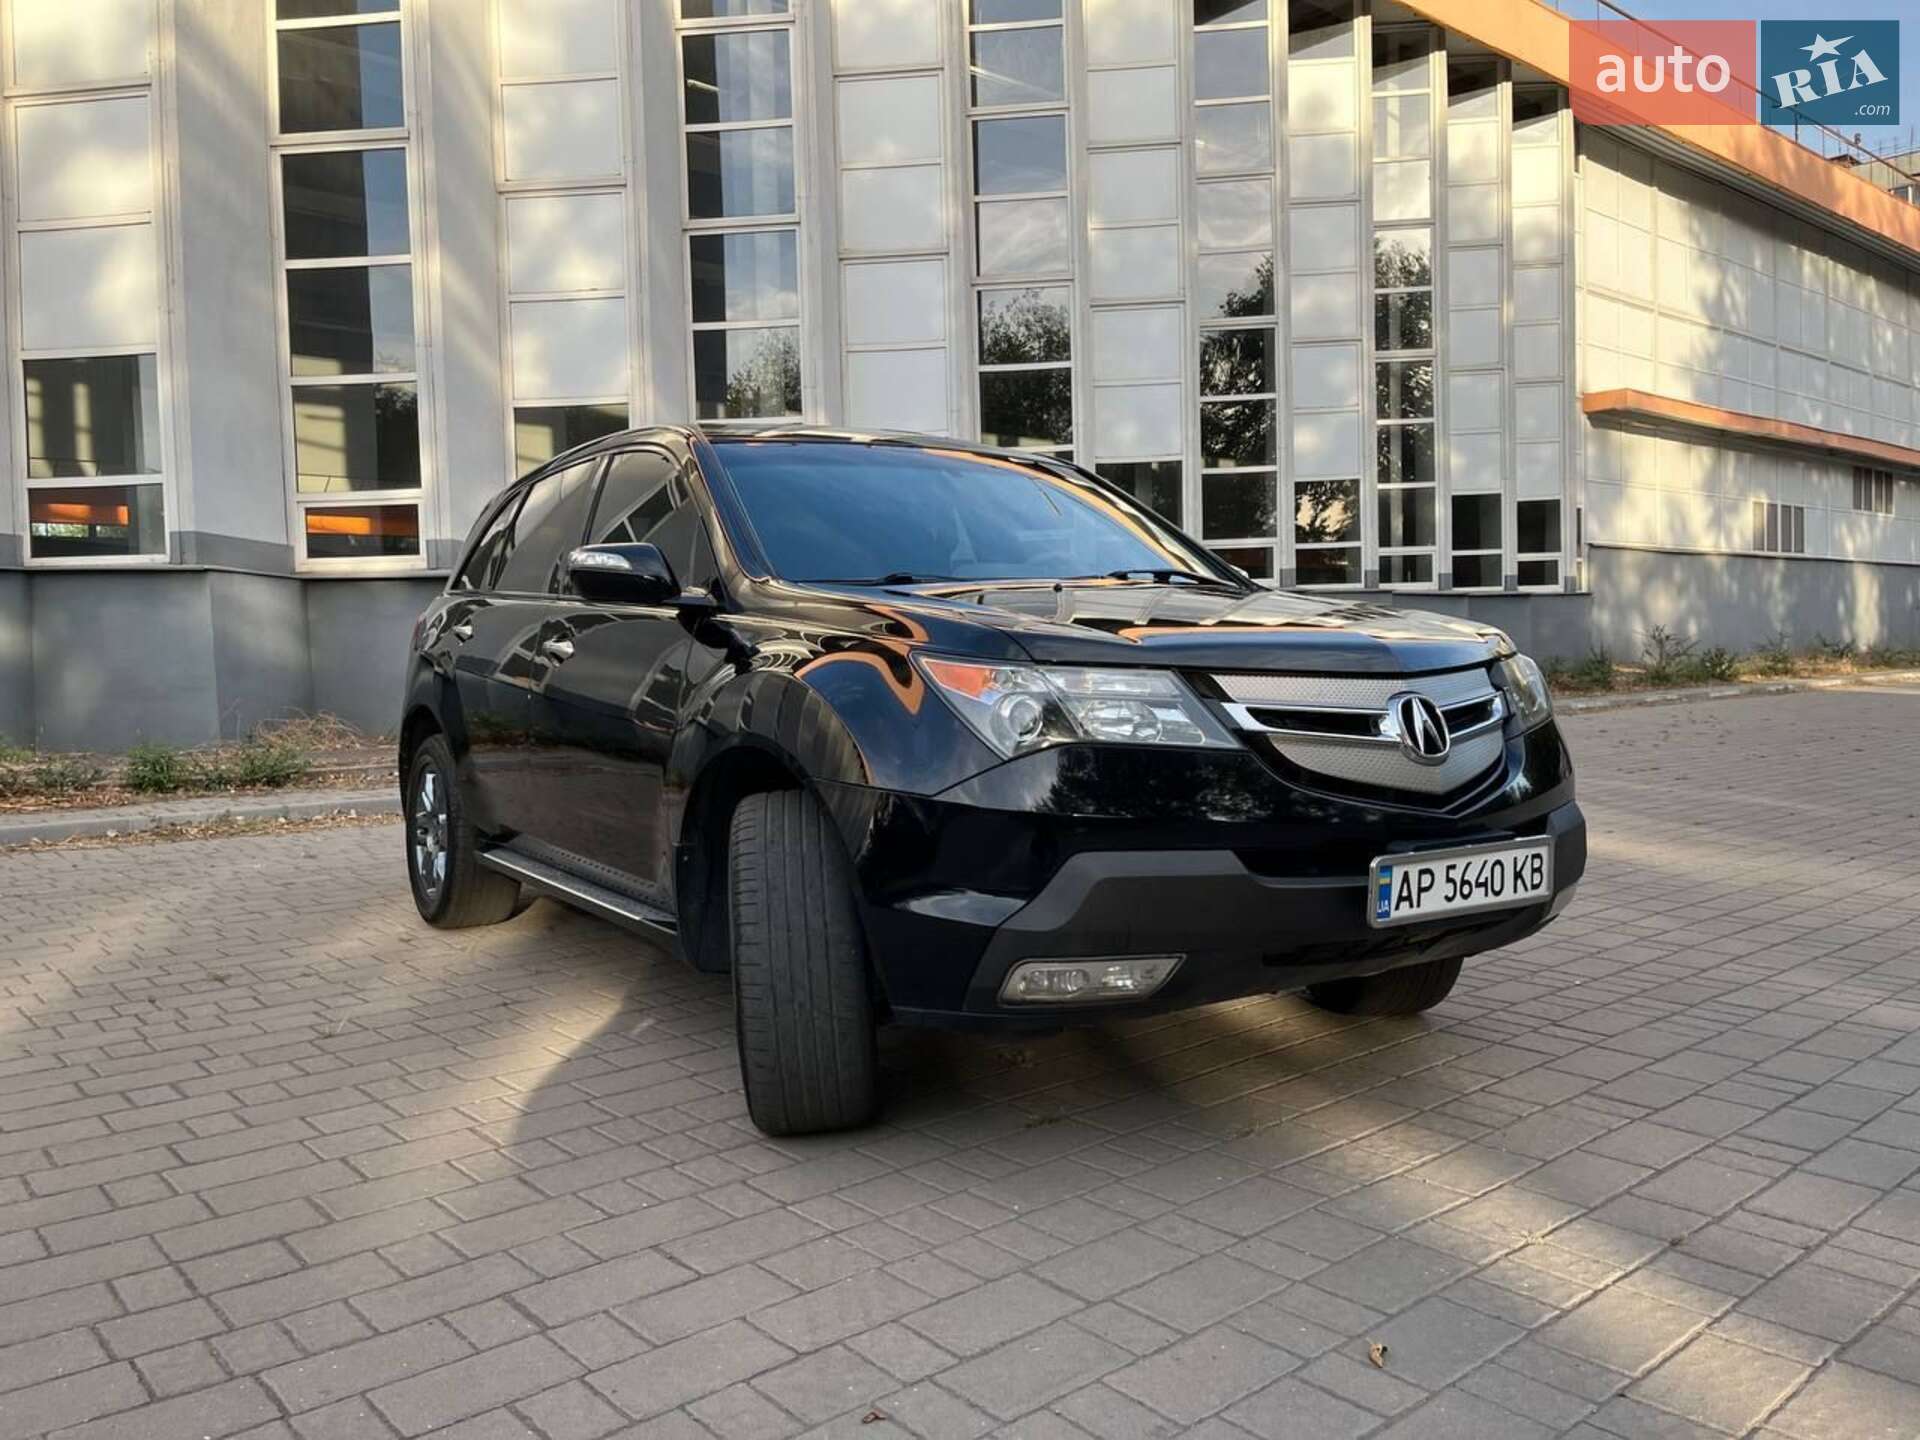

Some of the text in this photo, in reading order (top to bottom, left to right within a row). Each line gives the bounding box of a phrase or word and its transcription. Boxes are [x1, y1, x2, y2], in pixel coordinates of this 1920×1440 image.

[1394, 853, 1544, 911] AP 5640 KB
